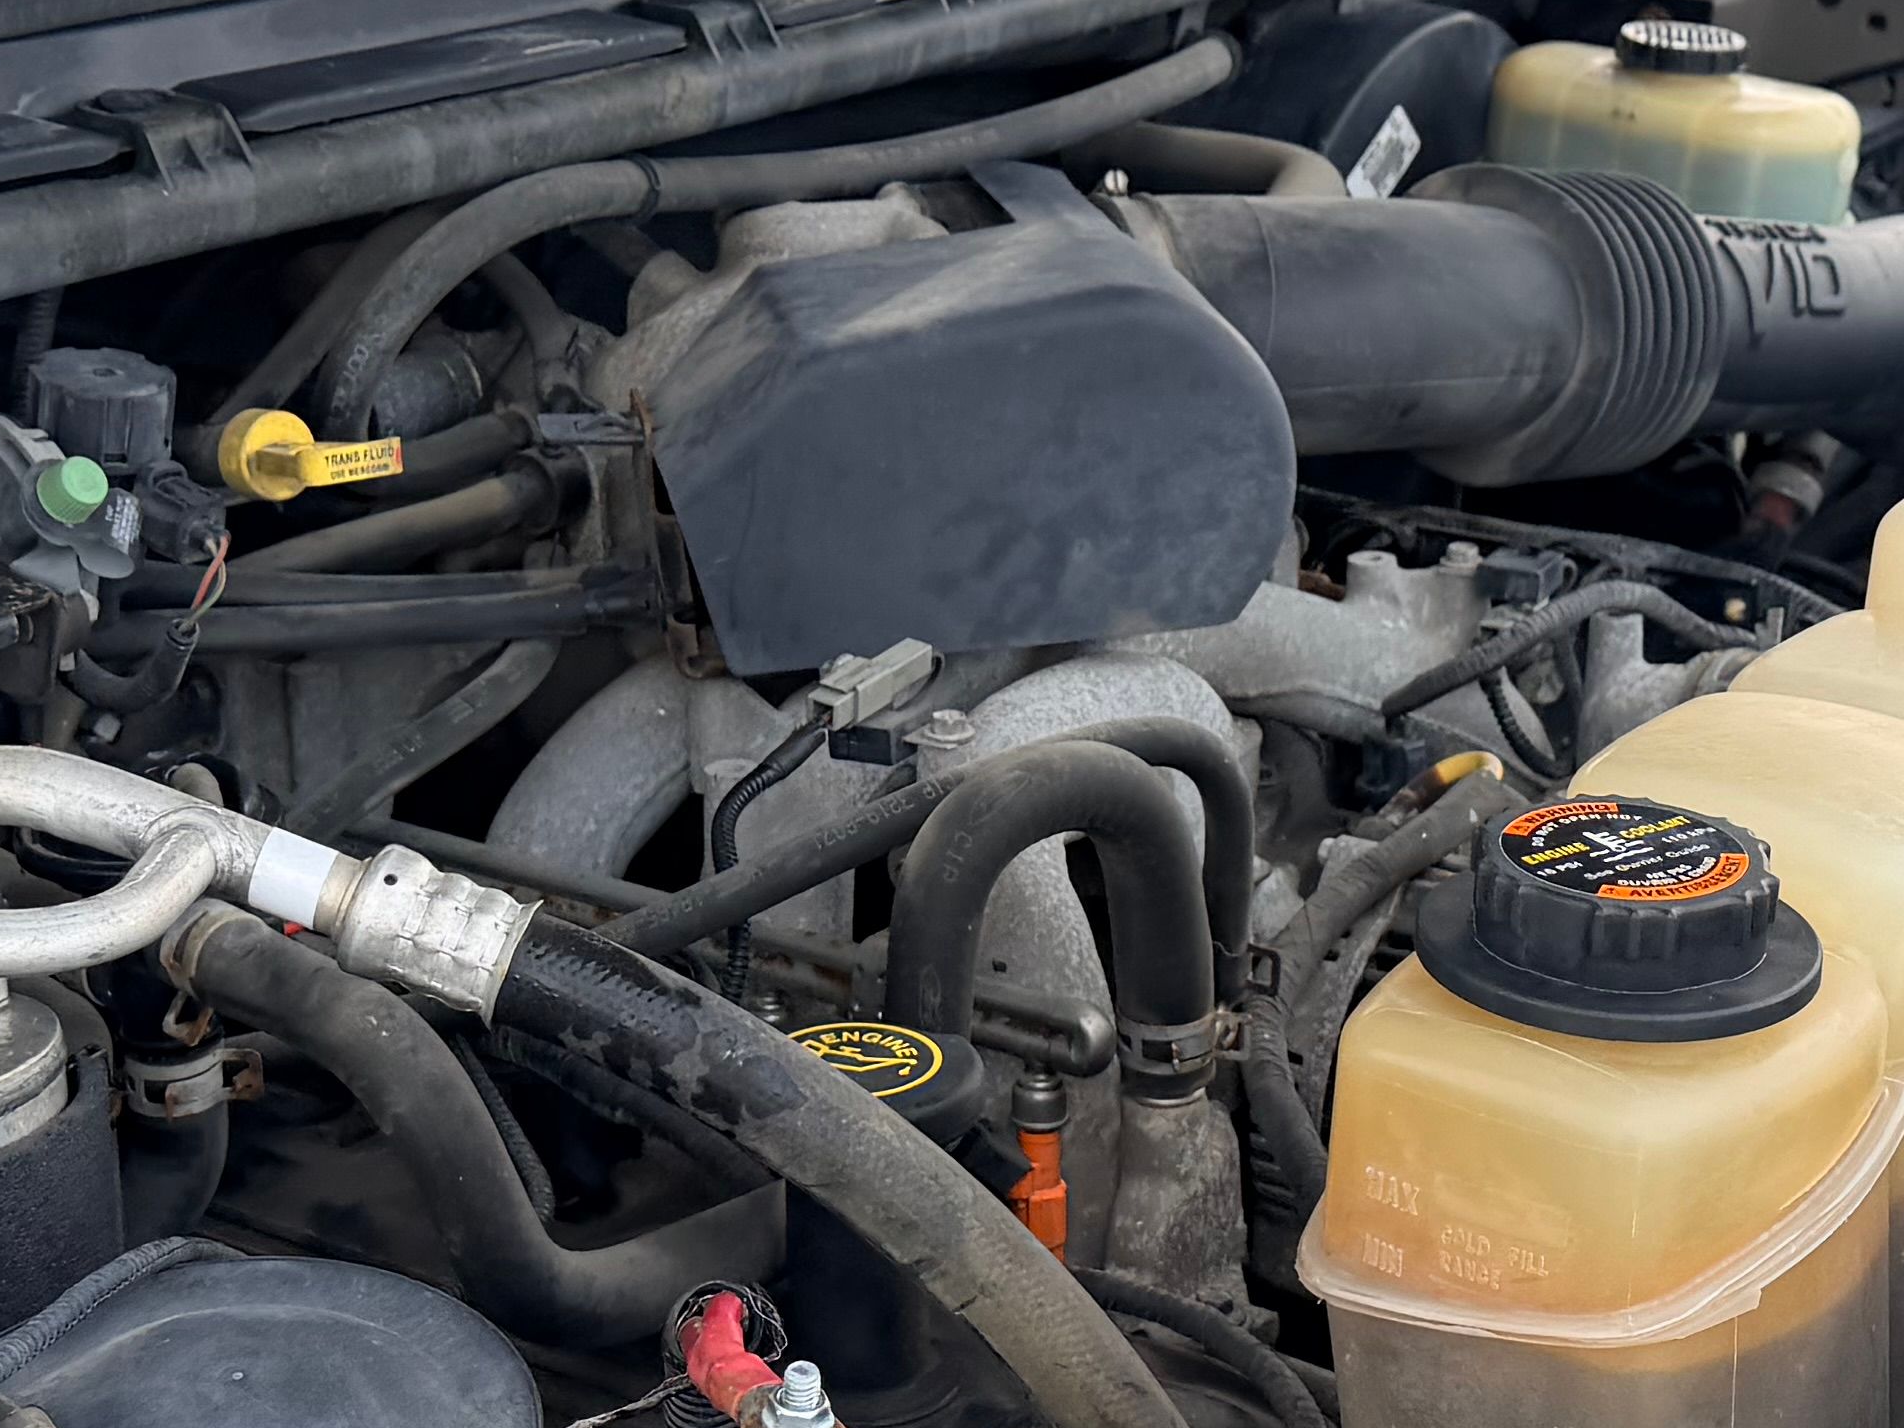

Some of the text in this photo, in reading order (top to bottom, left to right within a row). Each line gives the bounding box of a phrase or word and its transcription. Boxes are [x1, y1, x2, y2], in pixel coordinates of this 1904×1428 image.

[325, 446, 394, 465] TRANS FLUID
[1524, 804, 1609, 823] WARNING
[1520, 816, 1691, 864] ENGINE COOLANT
[820, 1031, 919, 1057] ENGINE
[1364, 1164, 1421, 1216] MAX
